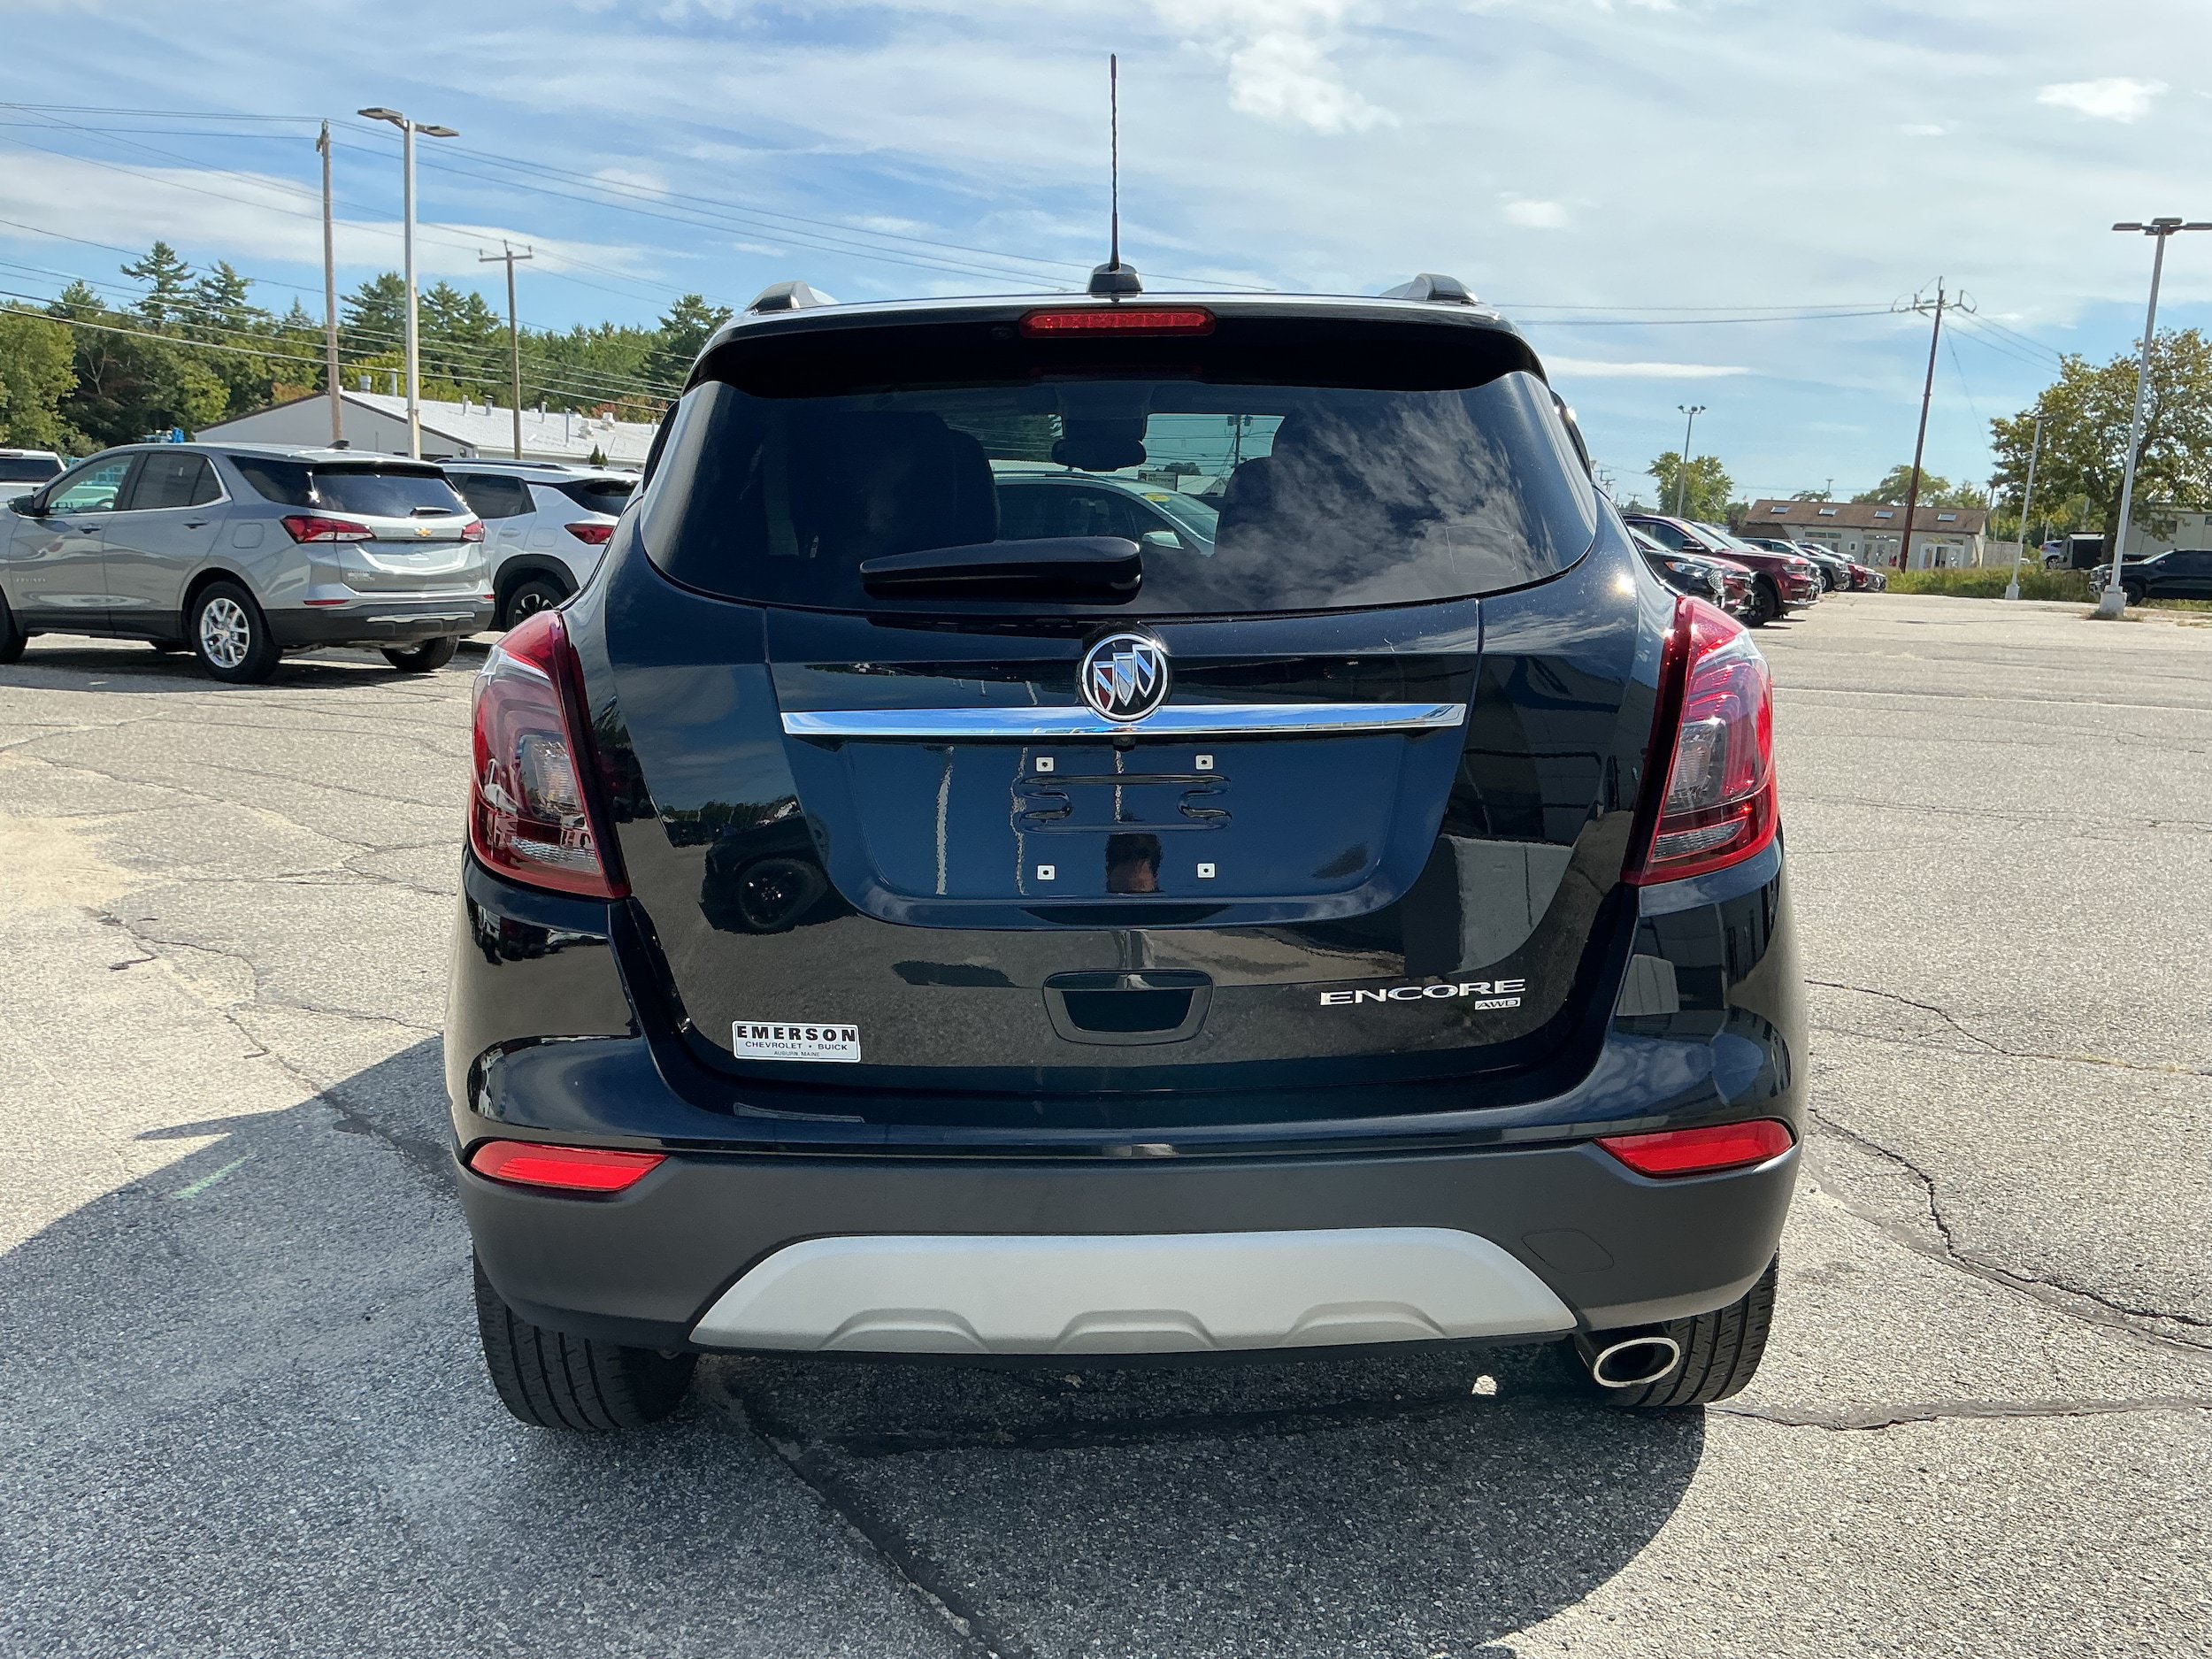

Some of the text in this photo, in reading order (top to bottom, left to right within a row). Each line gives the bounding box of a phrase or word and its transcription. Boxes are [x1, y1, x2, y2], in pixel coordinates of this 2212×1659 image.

[1320, 979, 1525, 1006] ENCORE
[1477, 999, 1518, 1009] AWD
[737, 1025, 856, 1041] EMERSON
